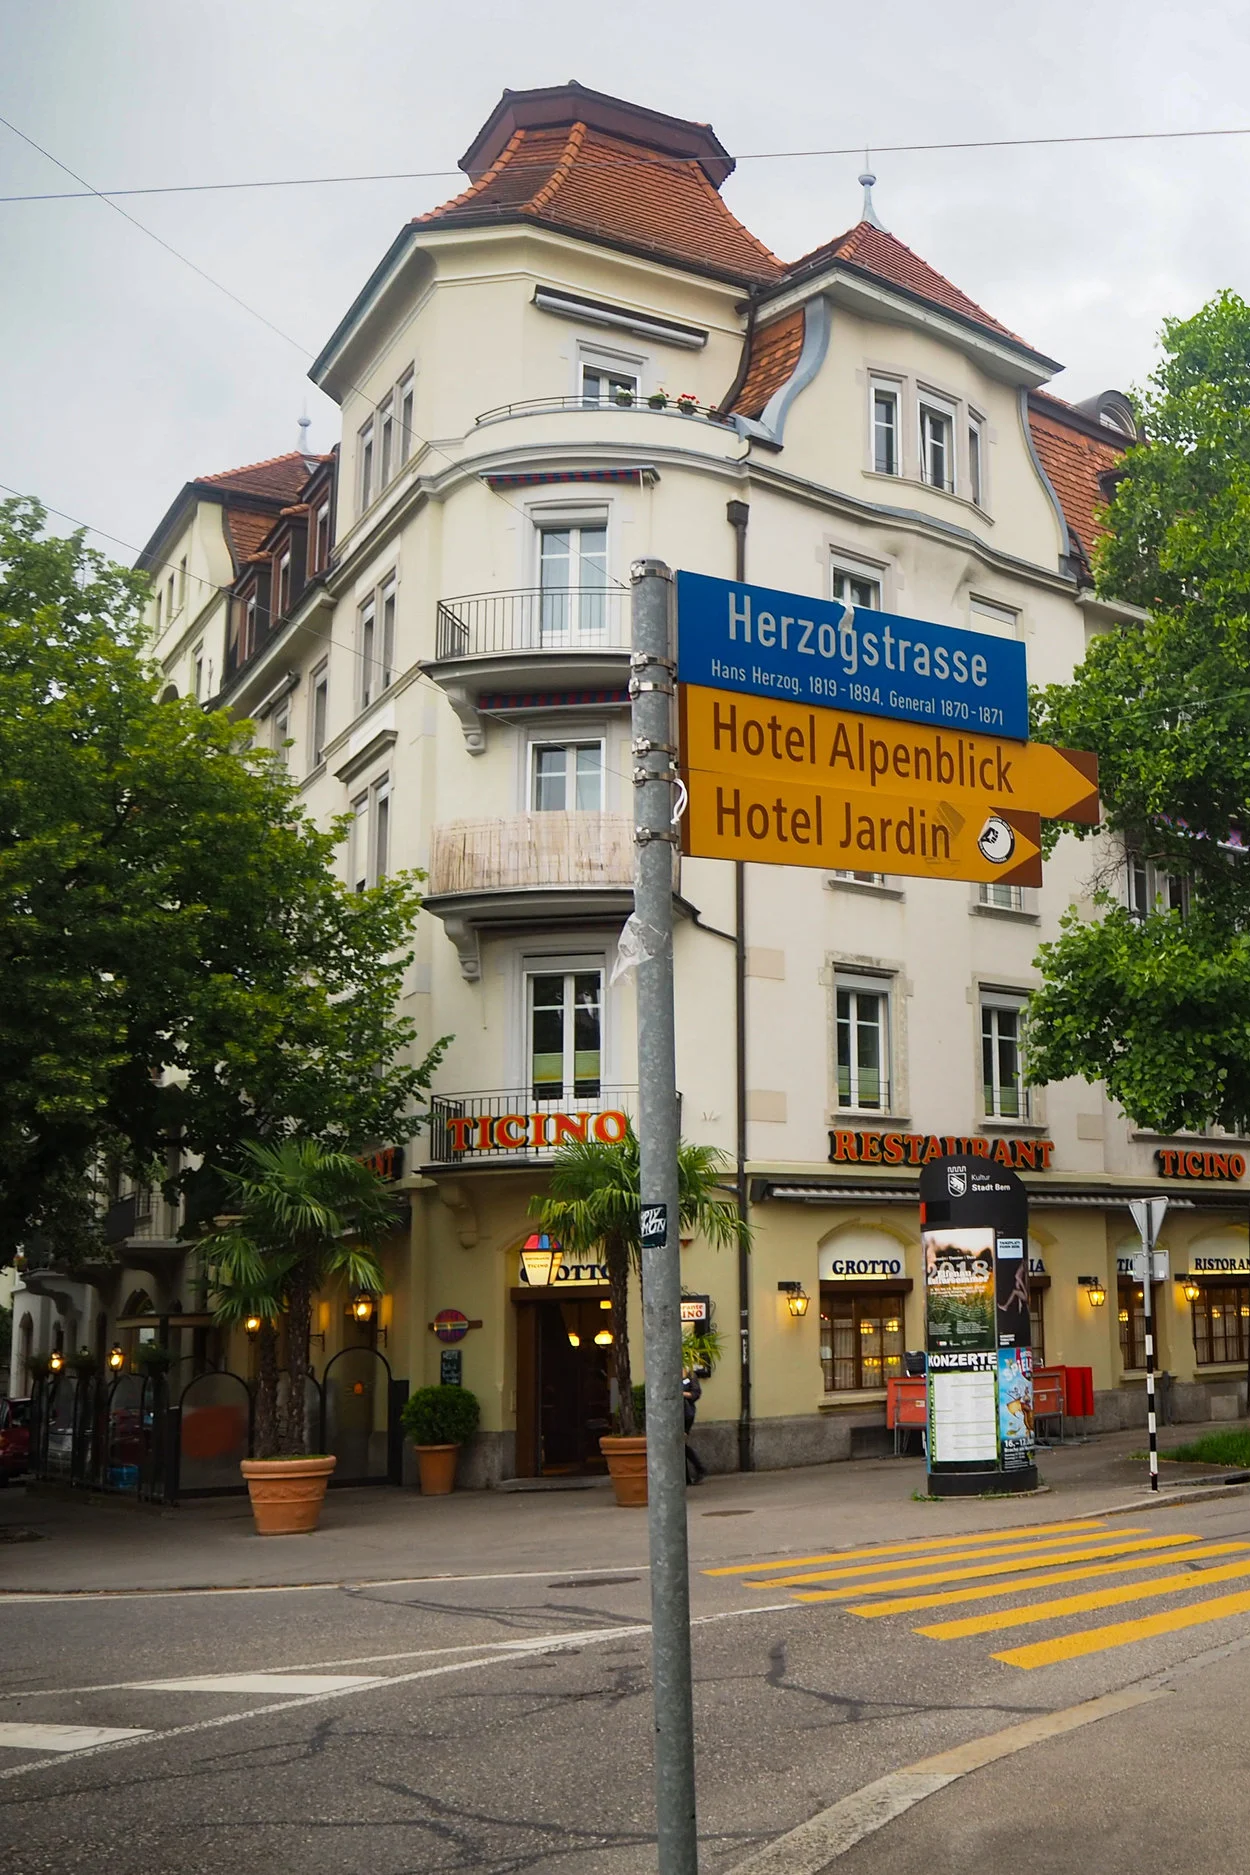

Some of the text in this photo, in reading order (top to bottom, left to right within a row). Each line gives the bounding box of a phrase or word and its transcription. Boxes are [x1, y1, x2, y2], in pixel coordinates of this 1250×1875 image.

[728, 591, 988, 687] Herzogstrasse
[711, 658, 746, 682] Hans
[889, 691, 936, 715] General
[713, 702, 1015, 793] Hotel Alpenblick
[716, 787, 823, 845] Hotel
[839, 801, 951, 858] Jardin
[446, 1110, 627, 1151] TICINO
[829, 1130, 1055, 1169] RESTAURANT
[1156, 1149, 1246, 1180] TICINO
[971, 1183, 1011, 1191] Stadt Bern
[832, 1259, 901, 1275] GROTTO
[928, 1352, 997, 1368] KONZERTE
